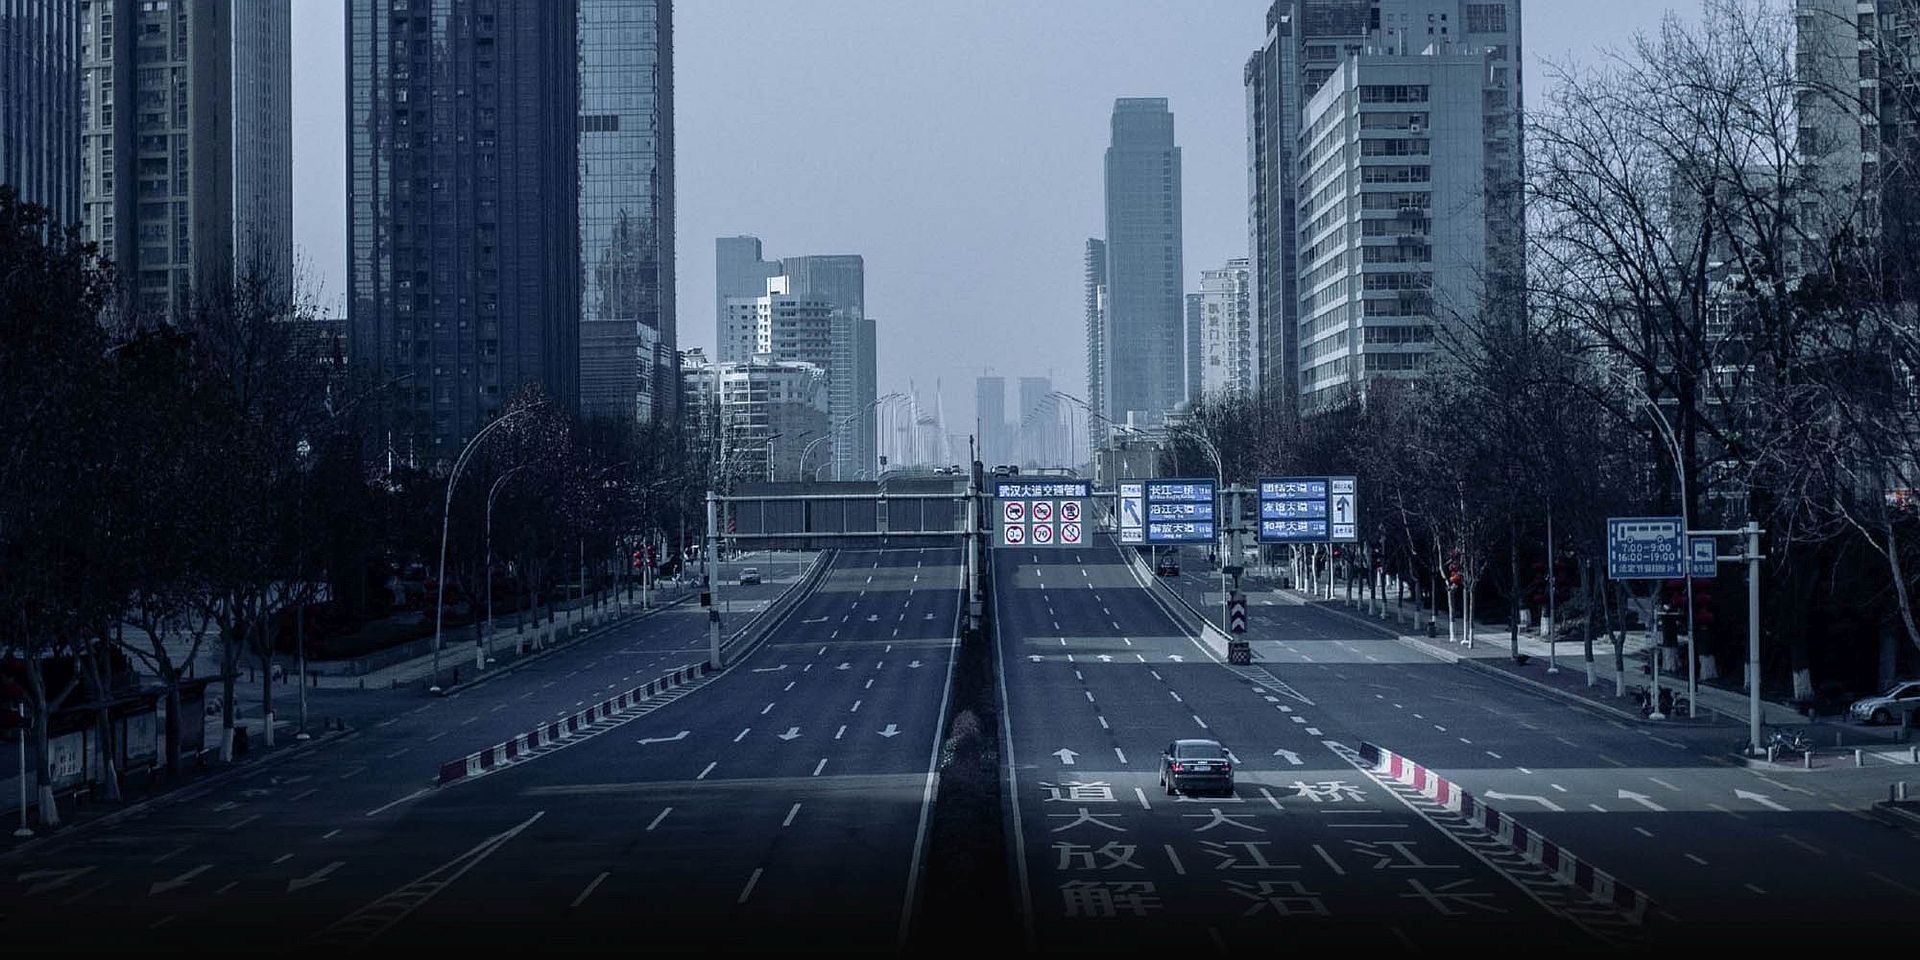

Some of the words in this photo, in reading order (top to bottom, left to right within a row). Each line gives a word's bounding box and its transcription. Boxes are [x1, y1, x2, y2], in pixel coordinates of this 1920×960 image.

[999, 484, 1087, 497] 武汉大道交通管制
[1149, 484, 1194, 495] 长江二桥
[1150, 504, 1195, 514] 沿江大道
[1150, 523, 1195, 533] 解放大道
[1263, 521, 1308, 532] 和平大道
